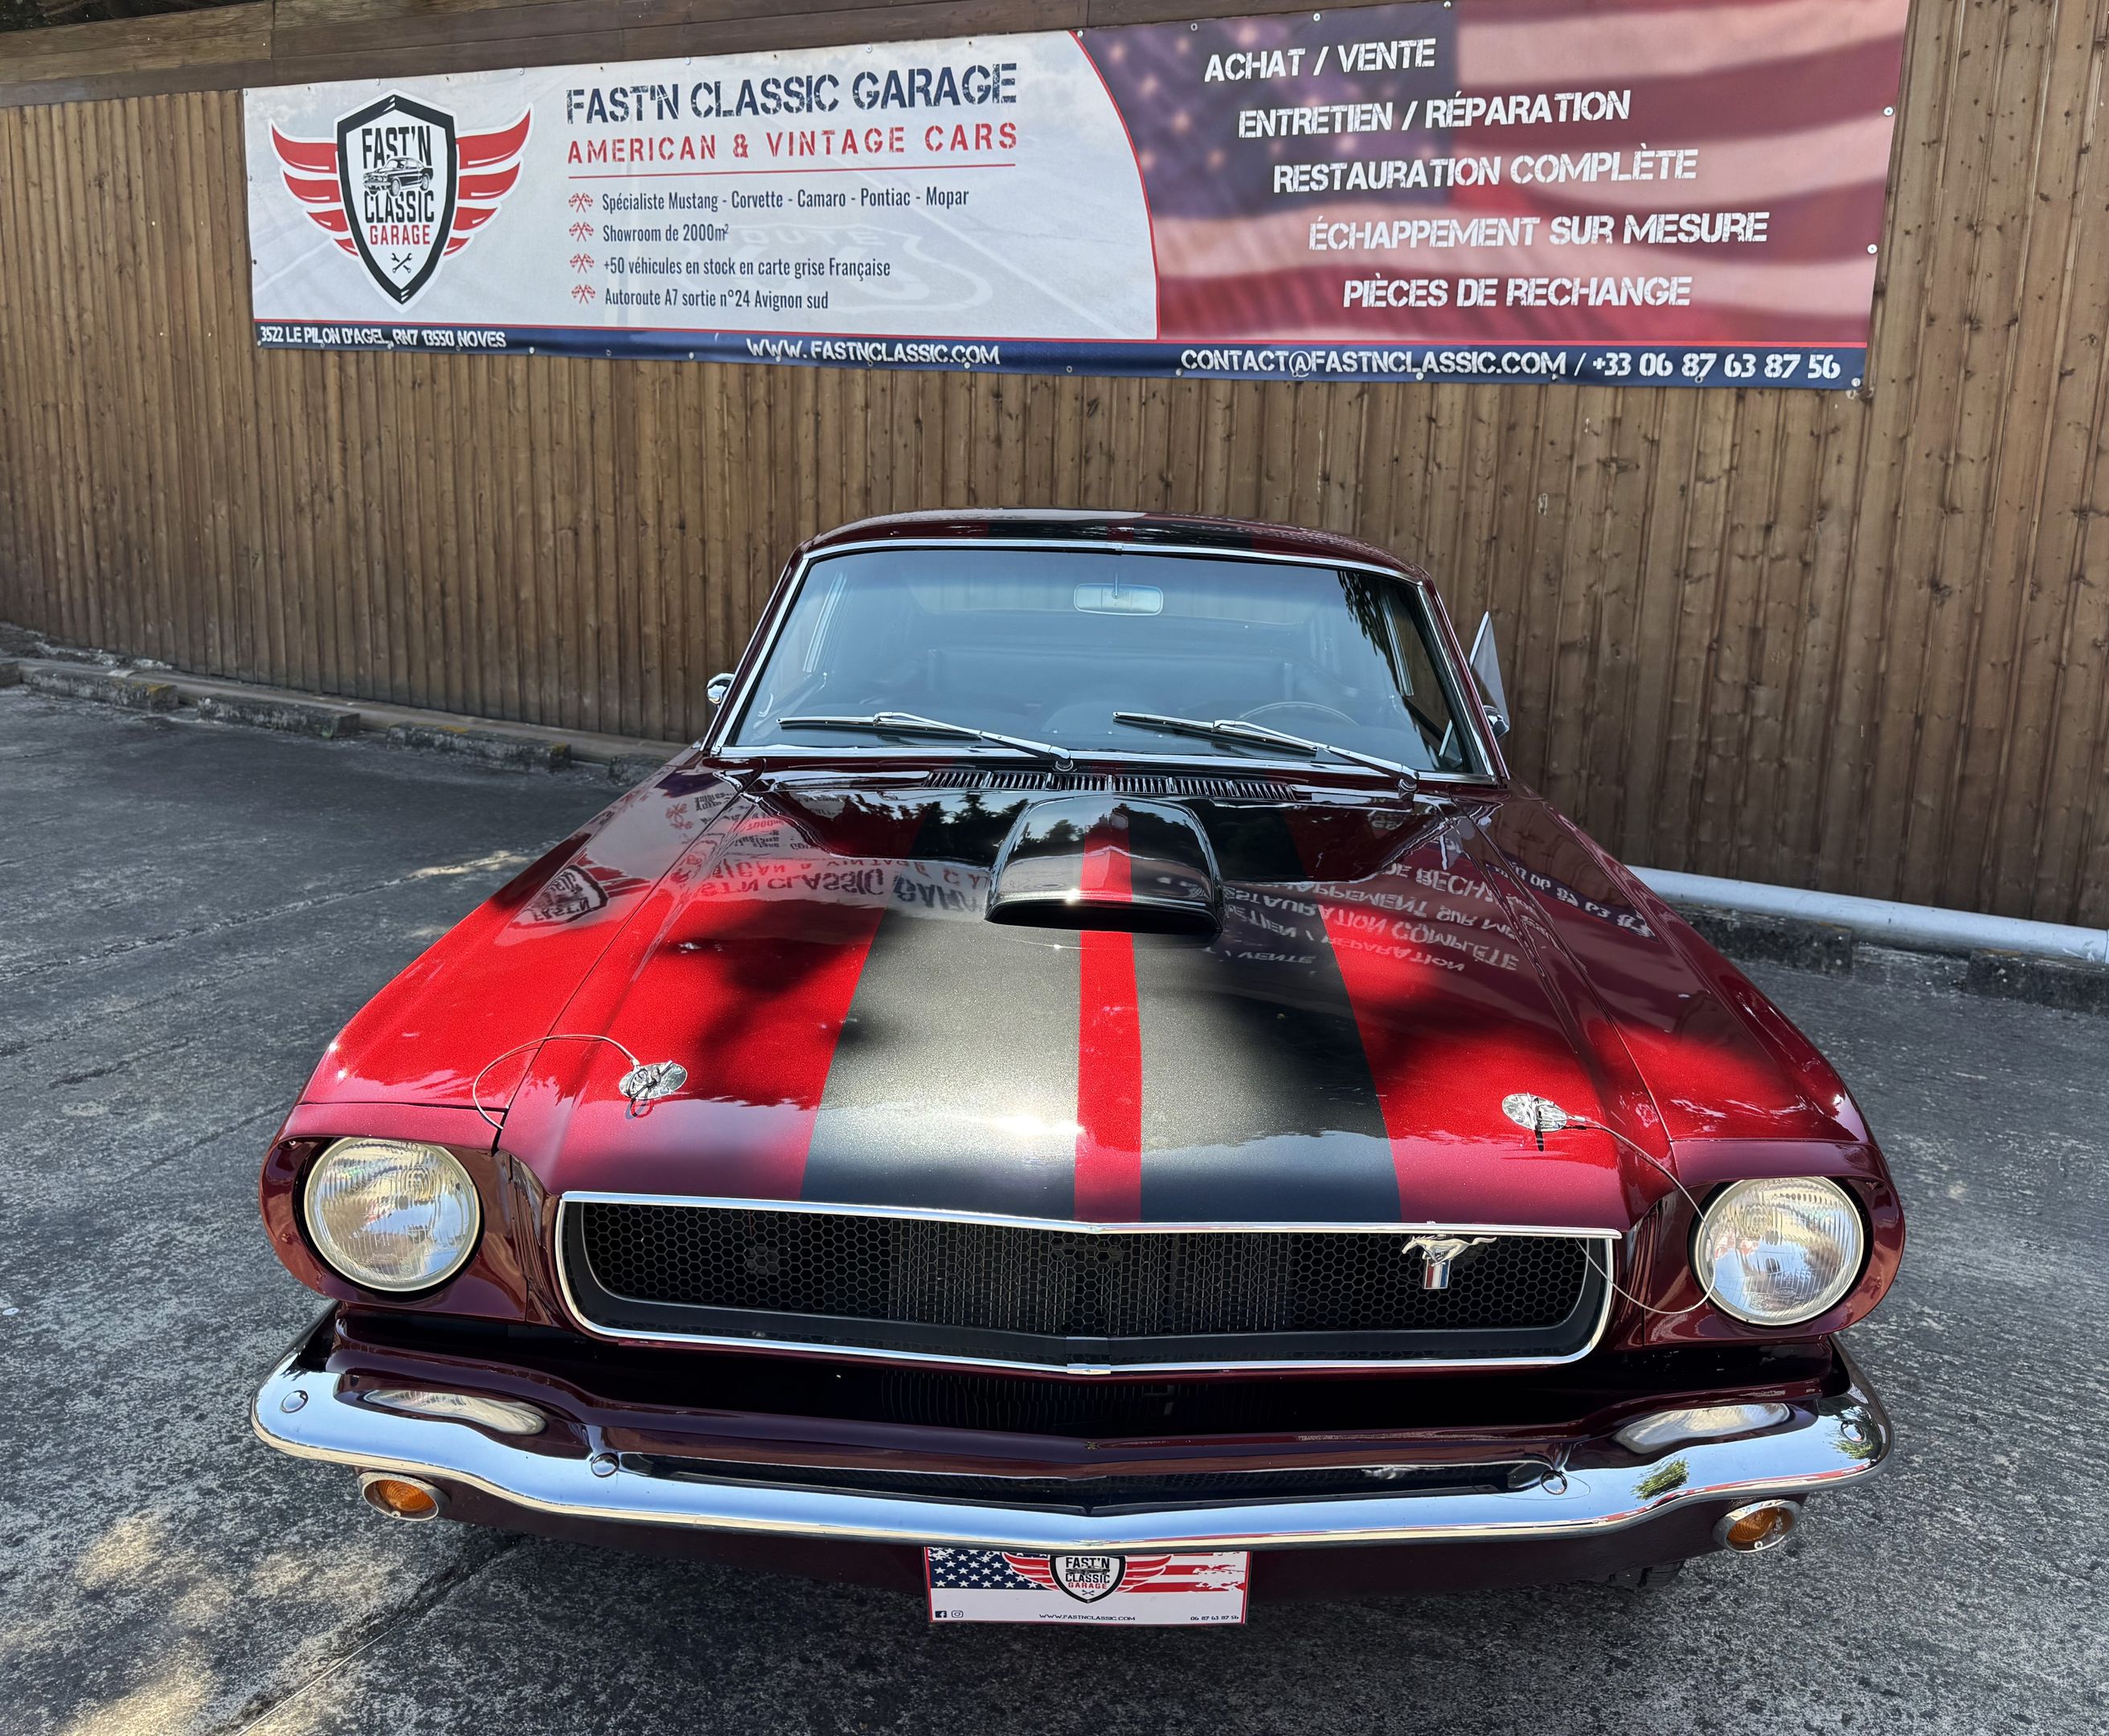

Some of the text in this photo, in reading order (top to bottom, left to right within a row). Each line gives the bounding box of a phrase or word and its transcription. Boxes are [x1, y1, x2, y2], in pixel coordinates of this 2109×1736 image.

[1204, 38, 1436, 82] ACHAT / VENTE
[566, 63, 1017, 125] FAST'N CLASSIC GARAGE
[1238, 90, 1632, 138] ENTRETIEN / RÉPARATION
[362, 125, 432, 170] FAST'N
[567, 122, 1017, 164] AMERICAN & VINTAGE CARS
[1273, 142, 1698, 193] RESTAURATION COMPLÈTE
[364, 190, 434, 223] CLASSIC
[602, 192, 665, 214] Spécialiste
[669, 191, 719, 212] Mustang
[731, 190, 783, 208] Corvette
[797, 190, 846, 207] Camaro
[861, 188, 911, 207] Pontiac
[926, 186, 969, 209] Mopar
[370, 224, 431, 245] GARAGE
[603, 223, 729, 242] Showroom de 2000m²
[1308, 211, 1770, 250] ÉCHAPPEMENT SUR MESURE
[604, 256, 891, 281] +50 véhicules en stock en carte grise Française
[605, 288, 661, 305] Autoroute
[665, 289, 678, 306] A7
[682, 289, 716, 307] sortie
[755, 290, 802, 311] Avignon
[807, 291, 829, 309] sud
[1343, 272, 1693, 308] PIÈCES DE RECHANGE
[260, 326, 284, 342] 3522
[285, 327, 302, 343] LE
[304, 328, 342, 344] PILON
[393, 329, 419, 345] RN7
[421, 330, 455, 346] 13550
[457, 331, 506, 348] NOVES
[1181, 350, 1841, 379] CONTACT@FASTNCLASSIC.COM / +33 06 87 63 87 56
[1066, 1557, 1110, 1569] FAST'N
[1066, 1573, 1111, 1583] CLASSIC
[1068, 1582, 1108, 1590] GARAGE
